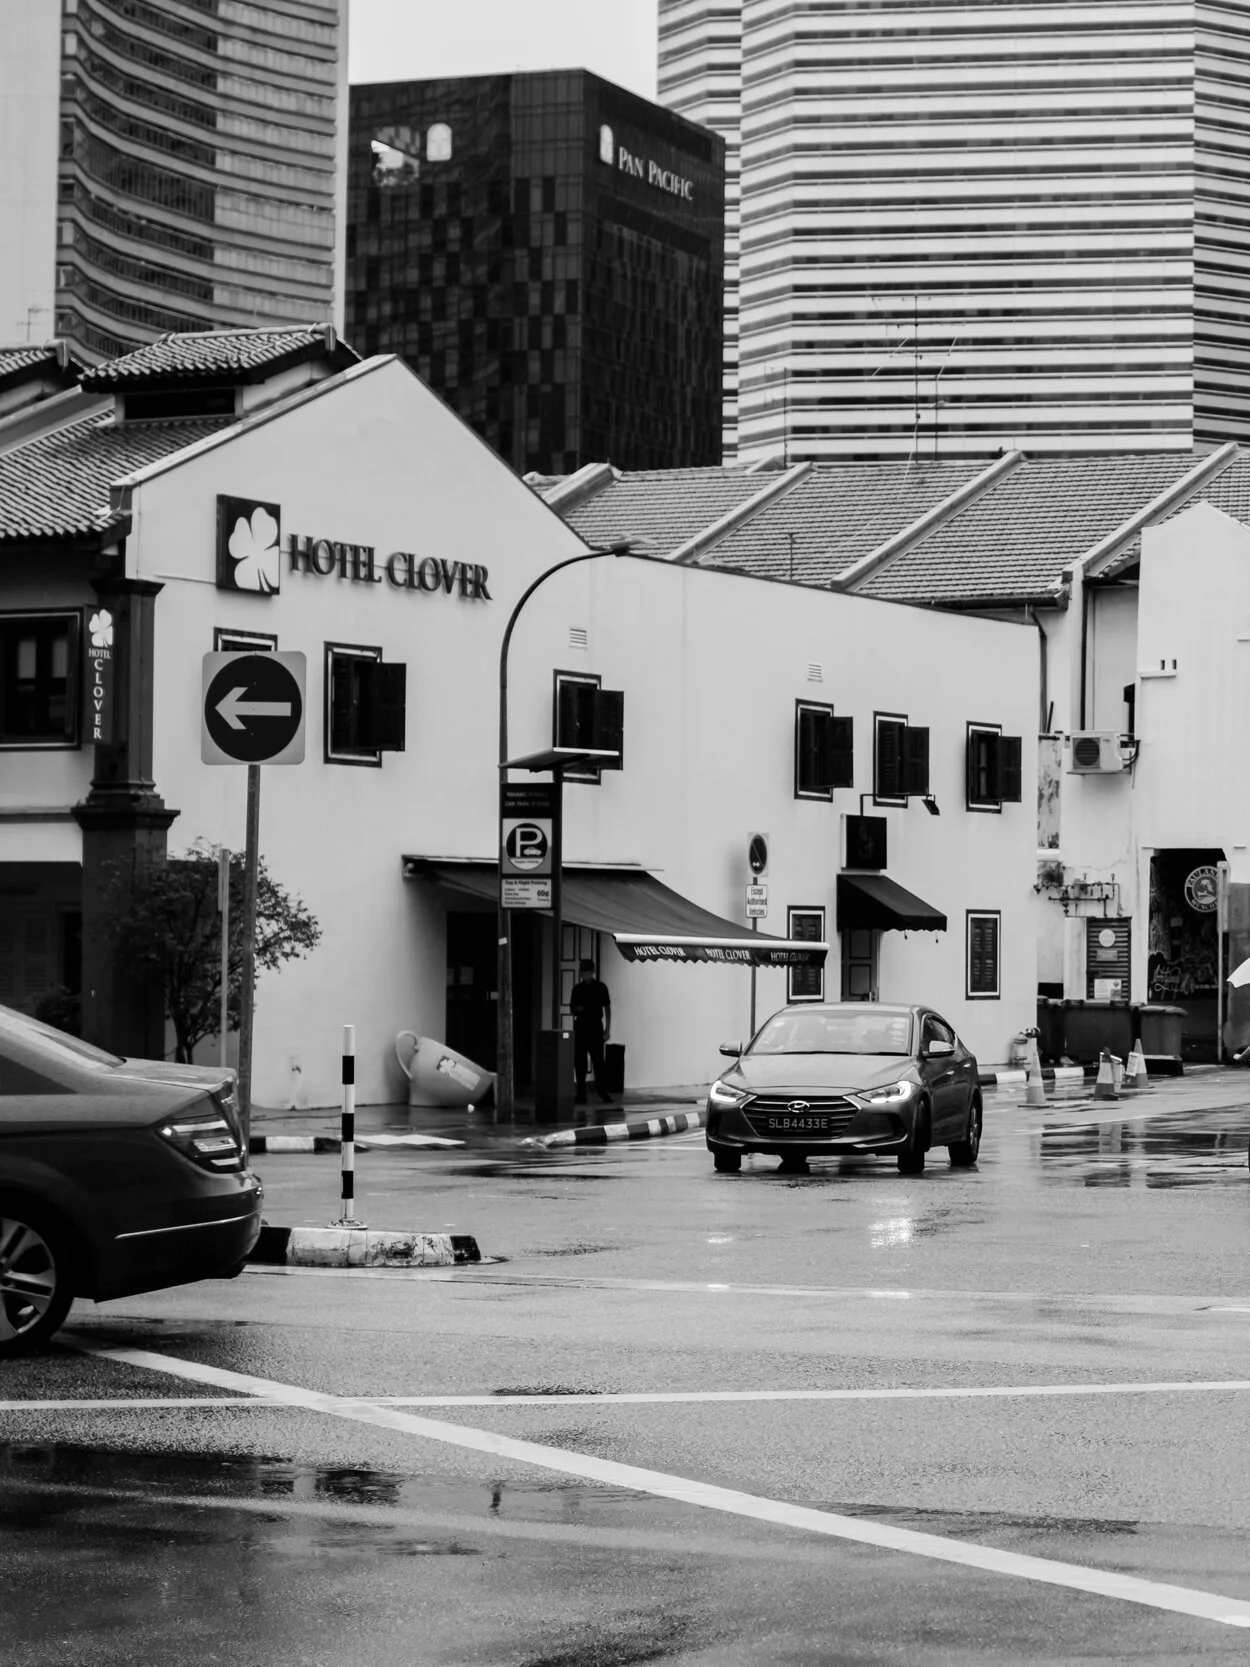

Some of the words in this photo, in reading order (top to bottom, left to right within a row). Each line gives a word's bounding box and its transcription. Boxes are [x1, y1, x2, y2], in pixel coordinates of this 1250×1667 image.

[618, 145, 644, 179] PAN
[648, 159, 693, 201] PACIFIC
[289, 533, 382, 583] HOTEL
[386, 551, 493, 601] CLOVER
[88, 647, 111, 659] HOTEL
[93, 658, 104, 740] CLOVER
[633, 945, 660, 956] HOTEL
[658, 945, 687, 957] CLOVER
[704, 948, 725, 960] HOTEL
[725, 949, 752, 961] CLOVER
[770, 951, 789, 963] HOTEL
[768, 1118, 829, 1129] SLB4433E
